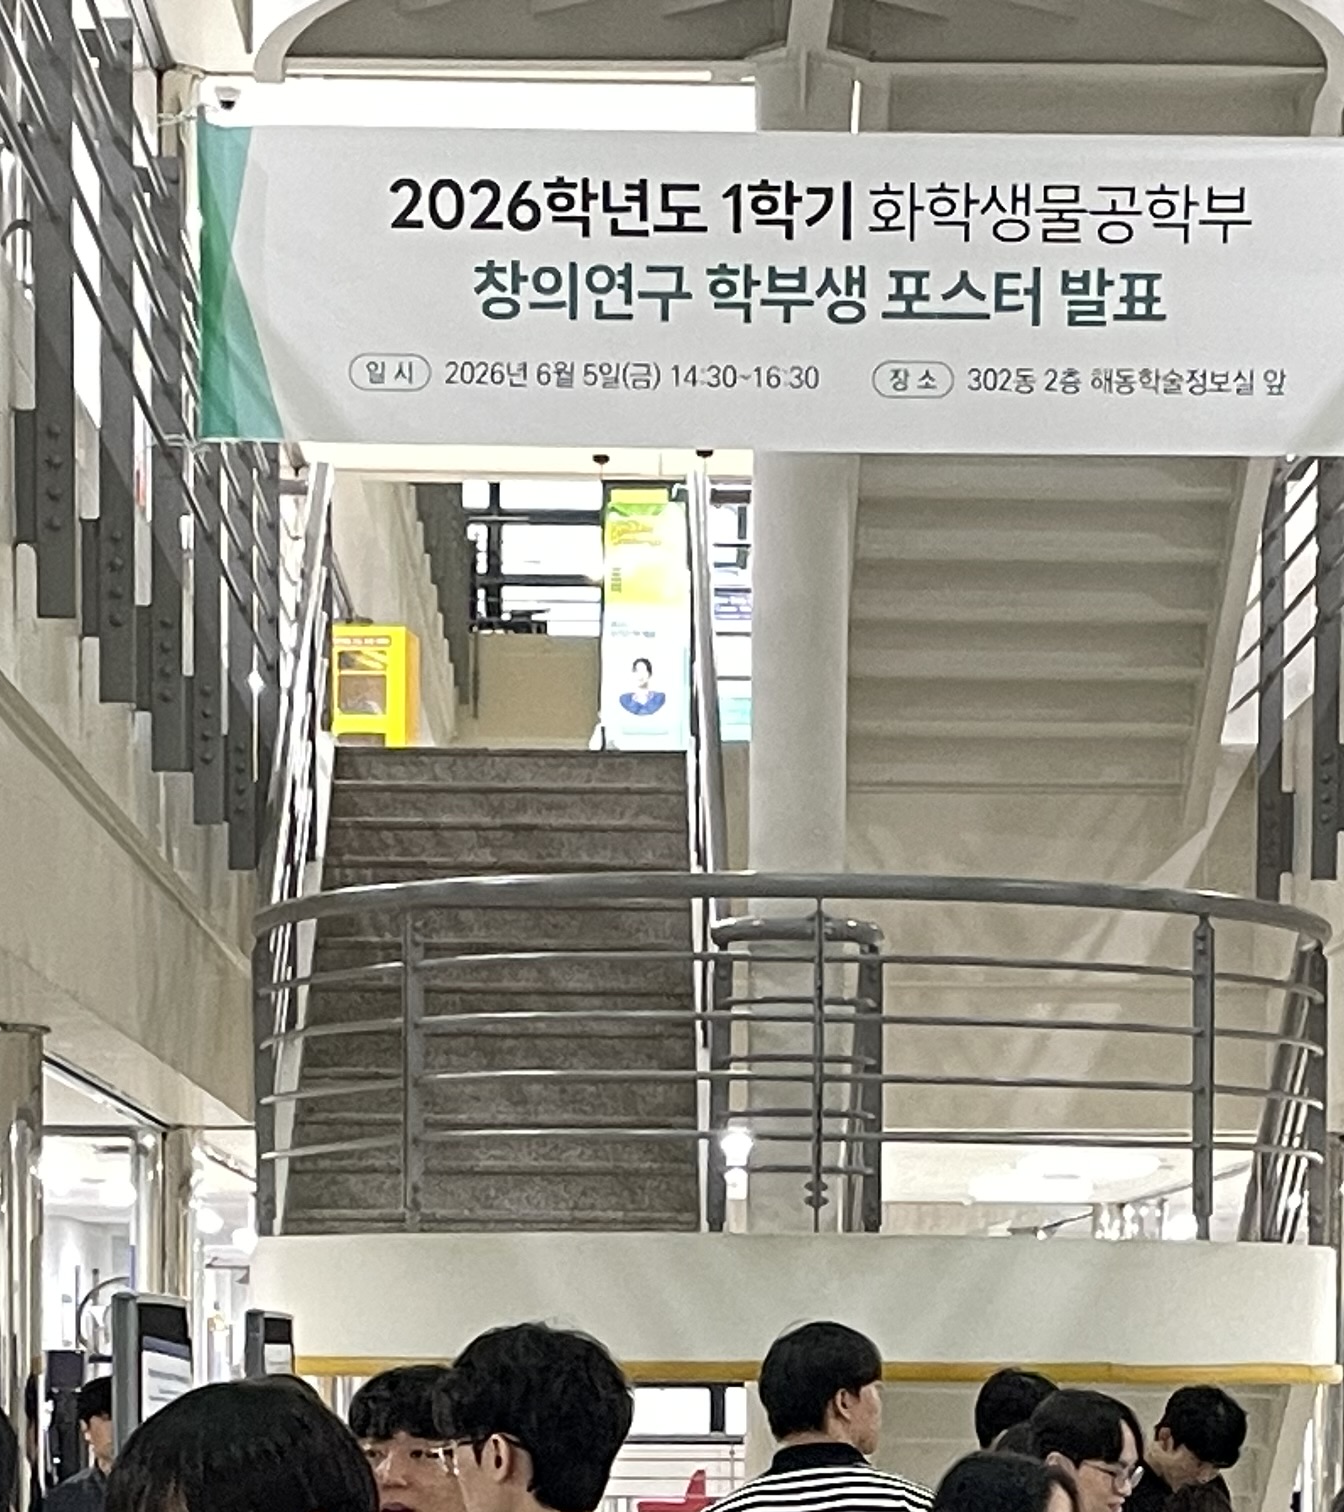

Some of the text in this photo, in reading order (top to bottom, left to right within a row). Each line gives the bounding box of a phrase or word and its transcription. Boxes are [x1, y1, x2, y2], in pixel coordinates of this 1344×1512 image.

[389, 175, 1253, 245] 2026학년도 1학기 화학생물공학부
[473, 259, 1168, 327] 창의연구 학부생 포스터 발표
[444, 360, 821, 391] 2026년 6월 5일(금) 14:30~16:30
[967, 367, 1287, 396] 302동 2층 해동학술정보실 앞
